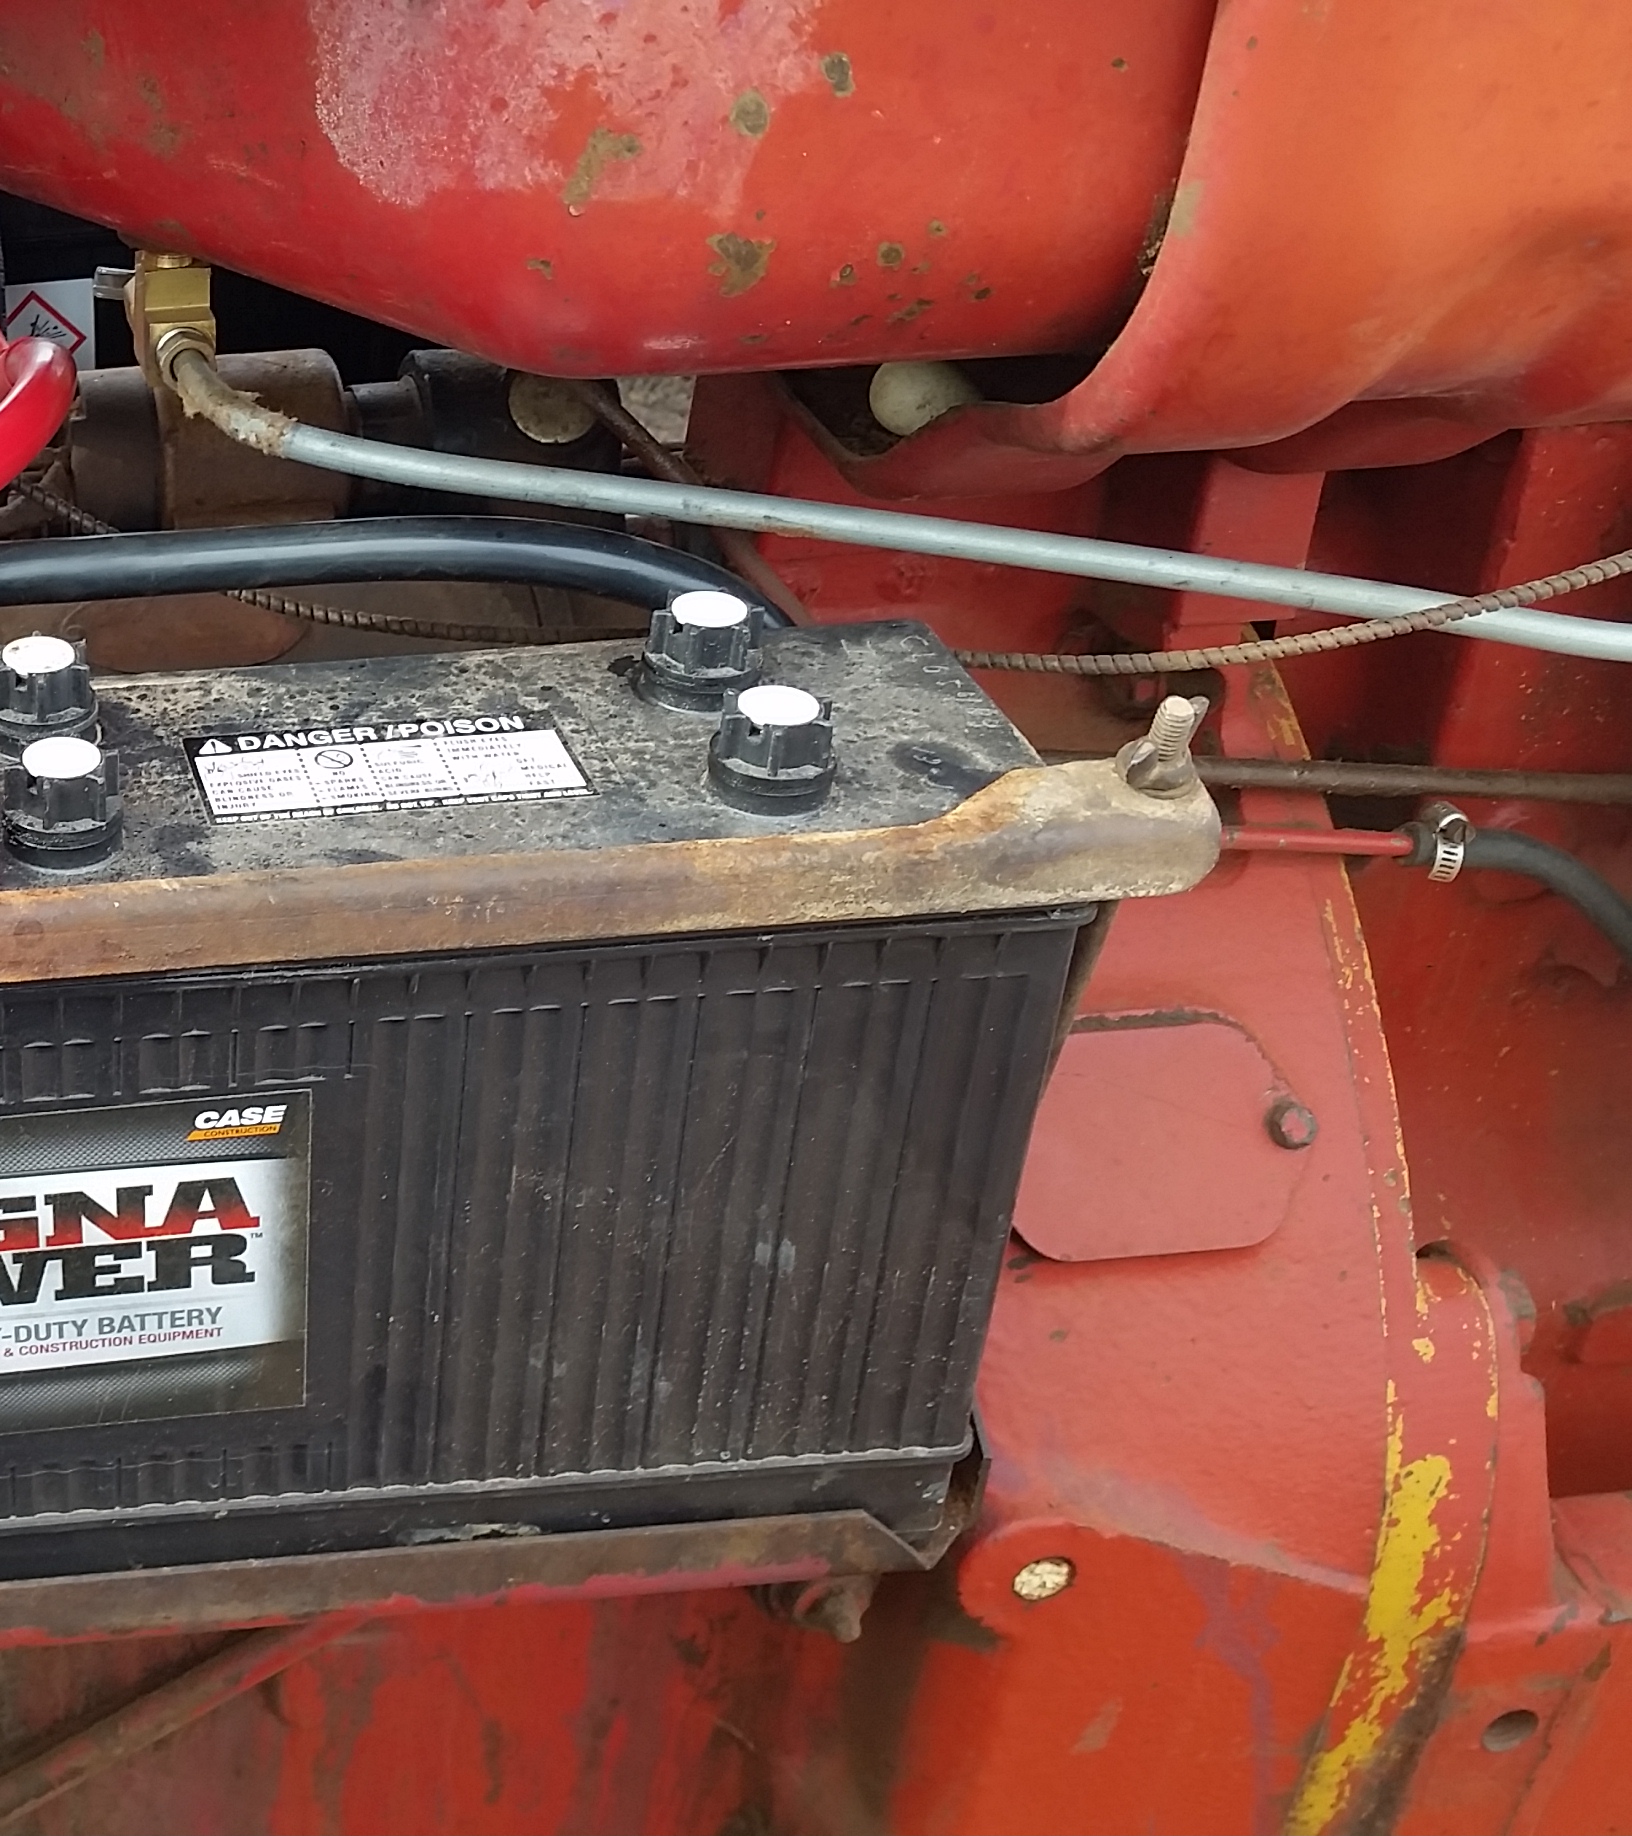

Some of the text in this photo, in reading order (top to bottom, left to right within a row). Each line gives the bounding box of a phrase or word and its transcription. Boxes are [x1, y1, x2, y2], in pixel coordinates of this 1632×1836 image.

[237, 726, 378, 751] DANGER
[194, 1104, 287, 1130] CASE
[203, 1125, 278, 1138] CONSTRUCTION
[97, 1305, 224, 1336] BATTERY
[3, 1347, 15, 1359] &
[18, 1334, 134, 1357] CONSTRUCTION
[138, 1326, 224, 1345] EQUIPMENT
